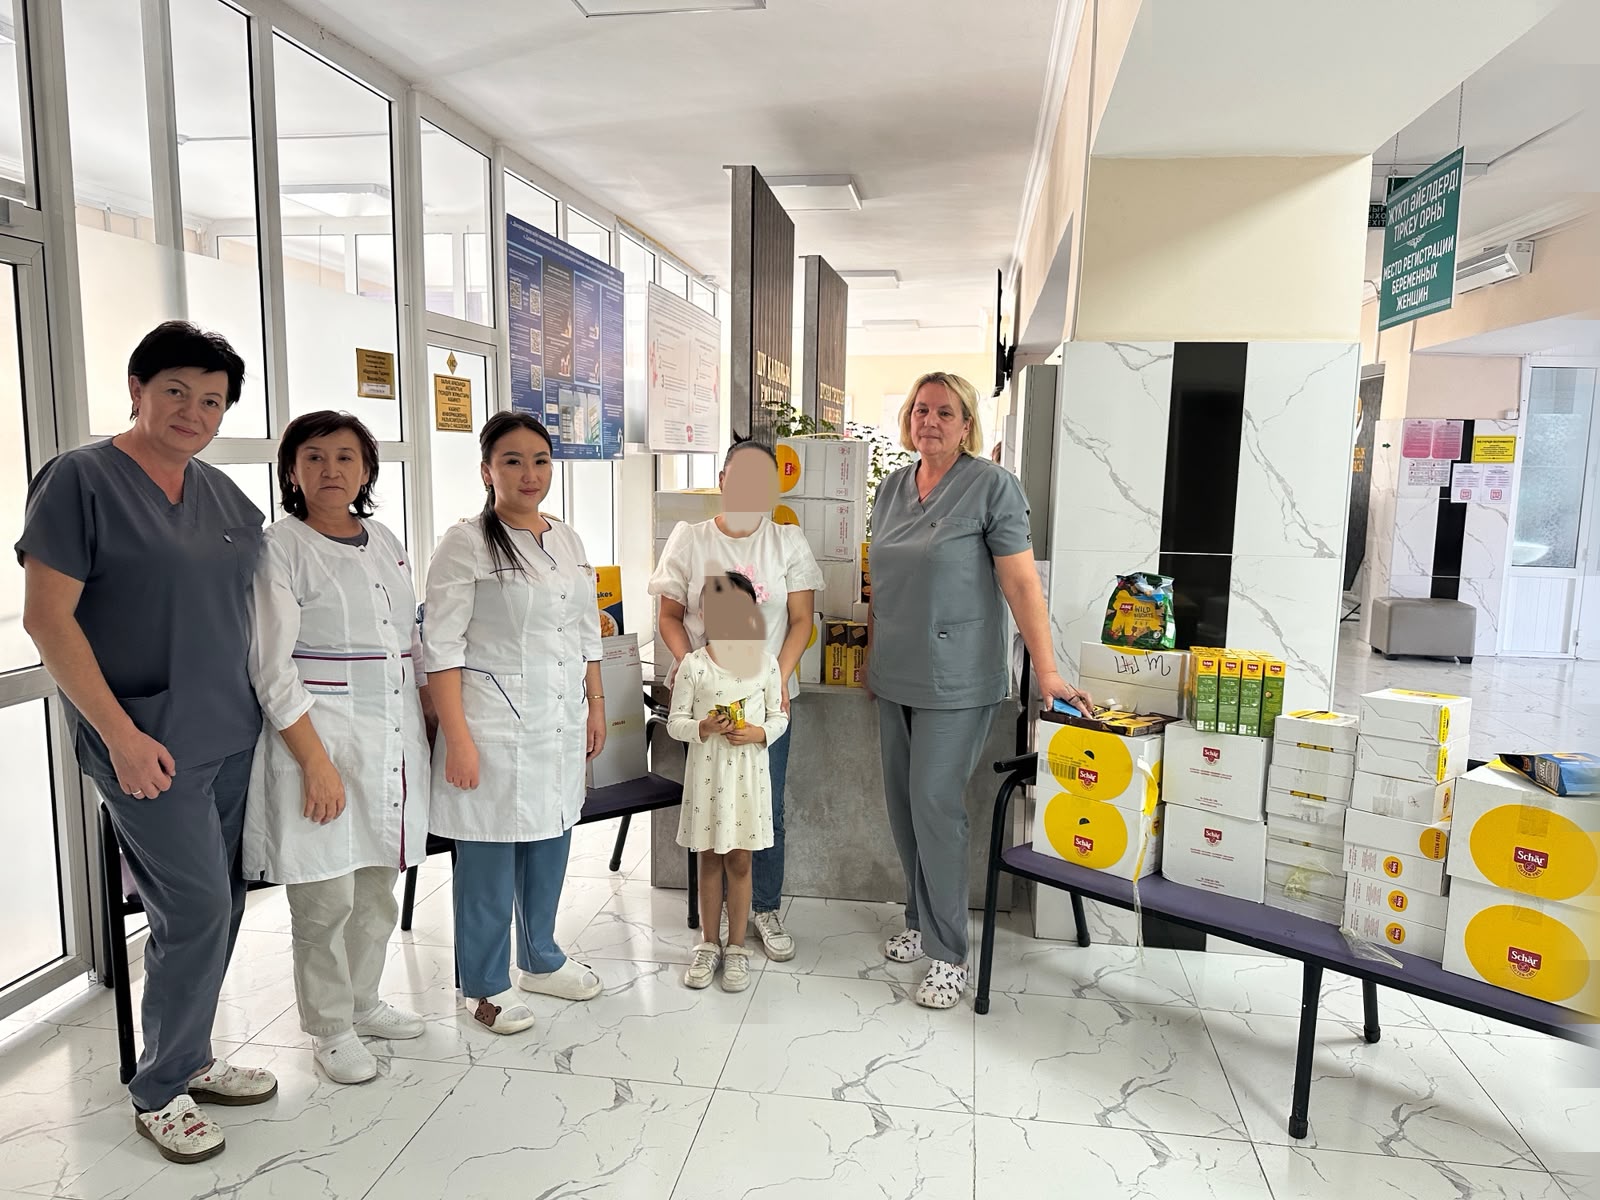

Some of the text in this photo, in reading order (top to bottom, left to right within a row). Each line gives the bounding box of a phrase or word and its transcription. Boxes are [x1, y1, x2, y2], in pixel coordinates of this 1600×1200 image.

[1420, 198, 1446, 228] ОРНЫ
[1383, 235, 1454, 280] МЕСТО РЕГИСТРАЦИИ
[1392, 262, 1438, 295] БЕРЕМЕННЫХ
[1396, 285, 1429, 312] ЖЕНЩИН
[1517, 850, 1545, 866] Schär
[1511, 950, 1538, 967] Schär
